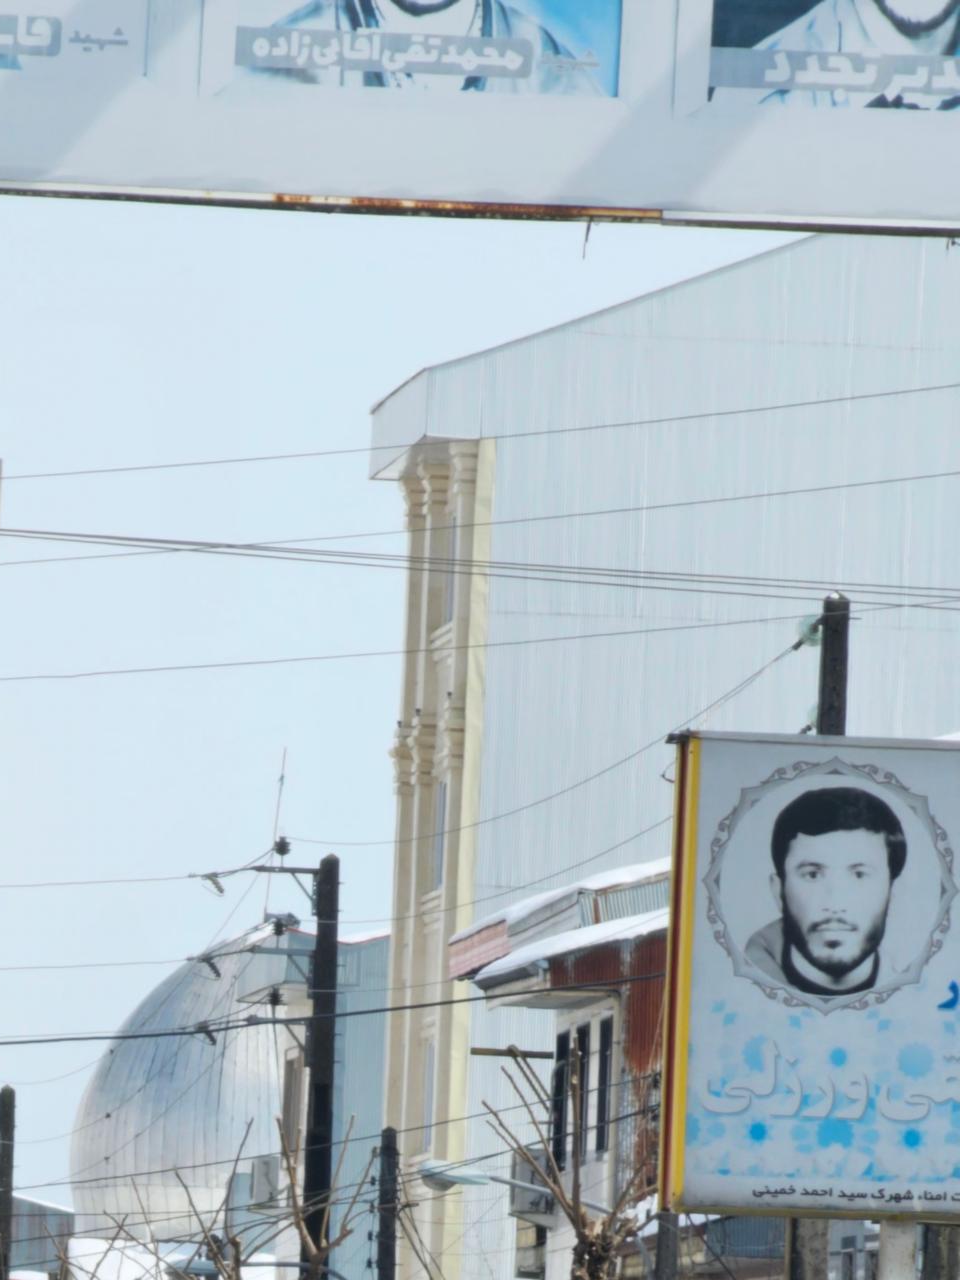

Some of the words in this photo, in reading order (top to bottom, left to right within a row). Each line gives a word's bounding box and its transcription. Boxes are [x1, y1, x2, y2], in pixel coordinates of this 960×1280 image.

[69, 27, 128, 52] شهید
[752, 1184, 797, 1198] خمینی
[800, 1187, 833, 1198] احمد
[837, 1189, 868, 1202] سید
[870, 1187, 914, 1203] شهرک
